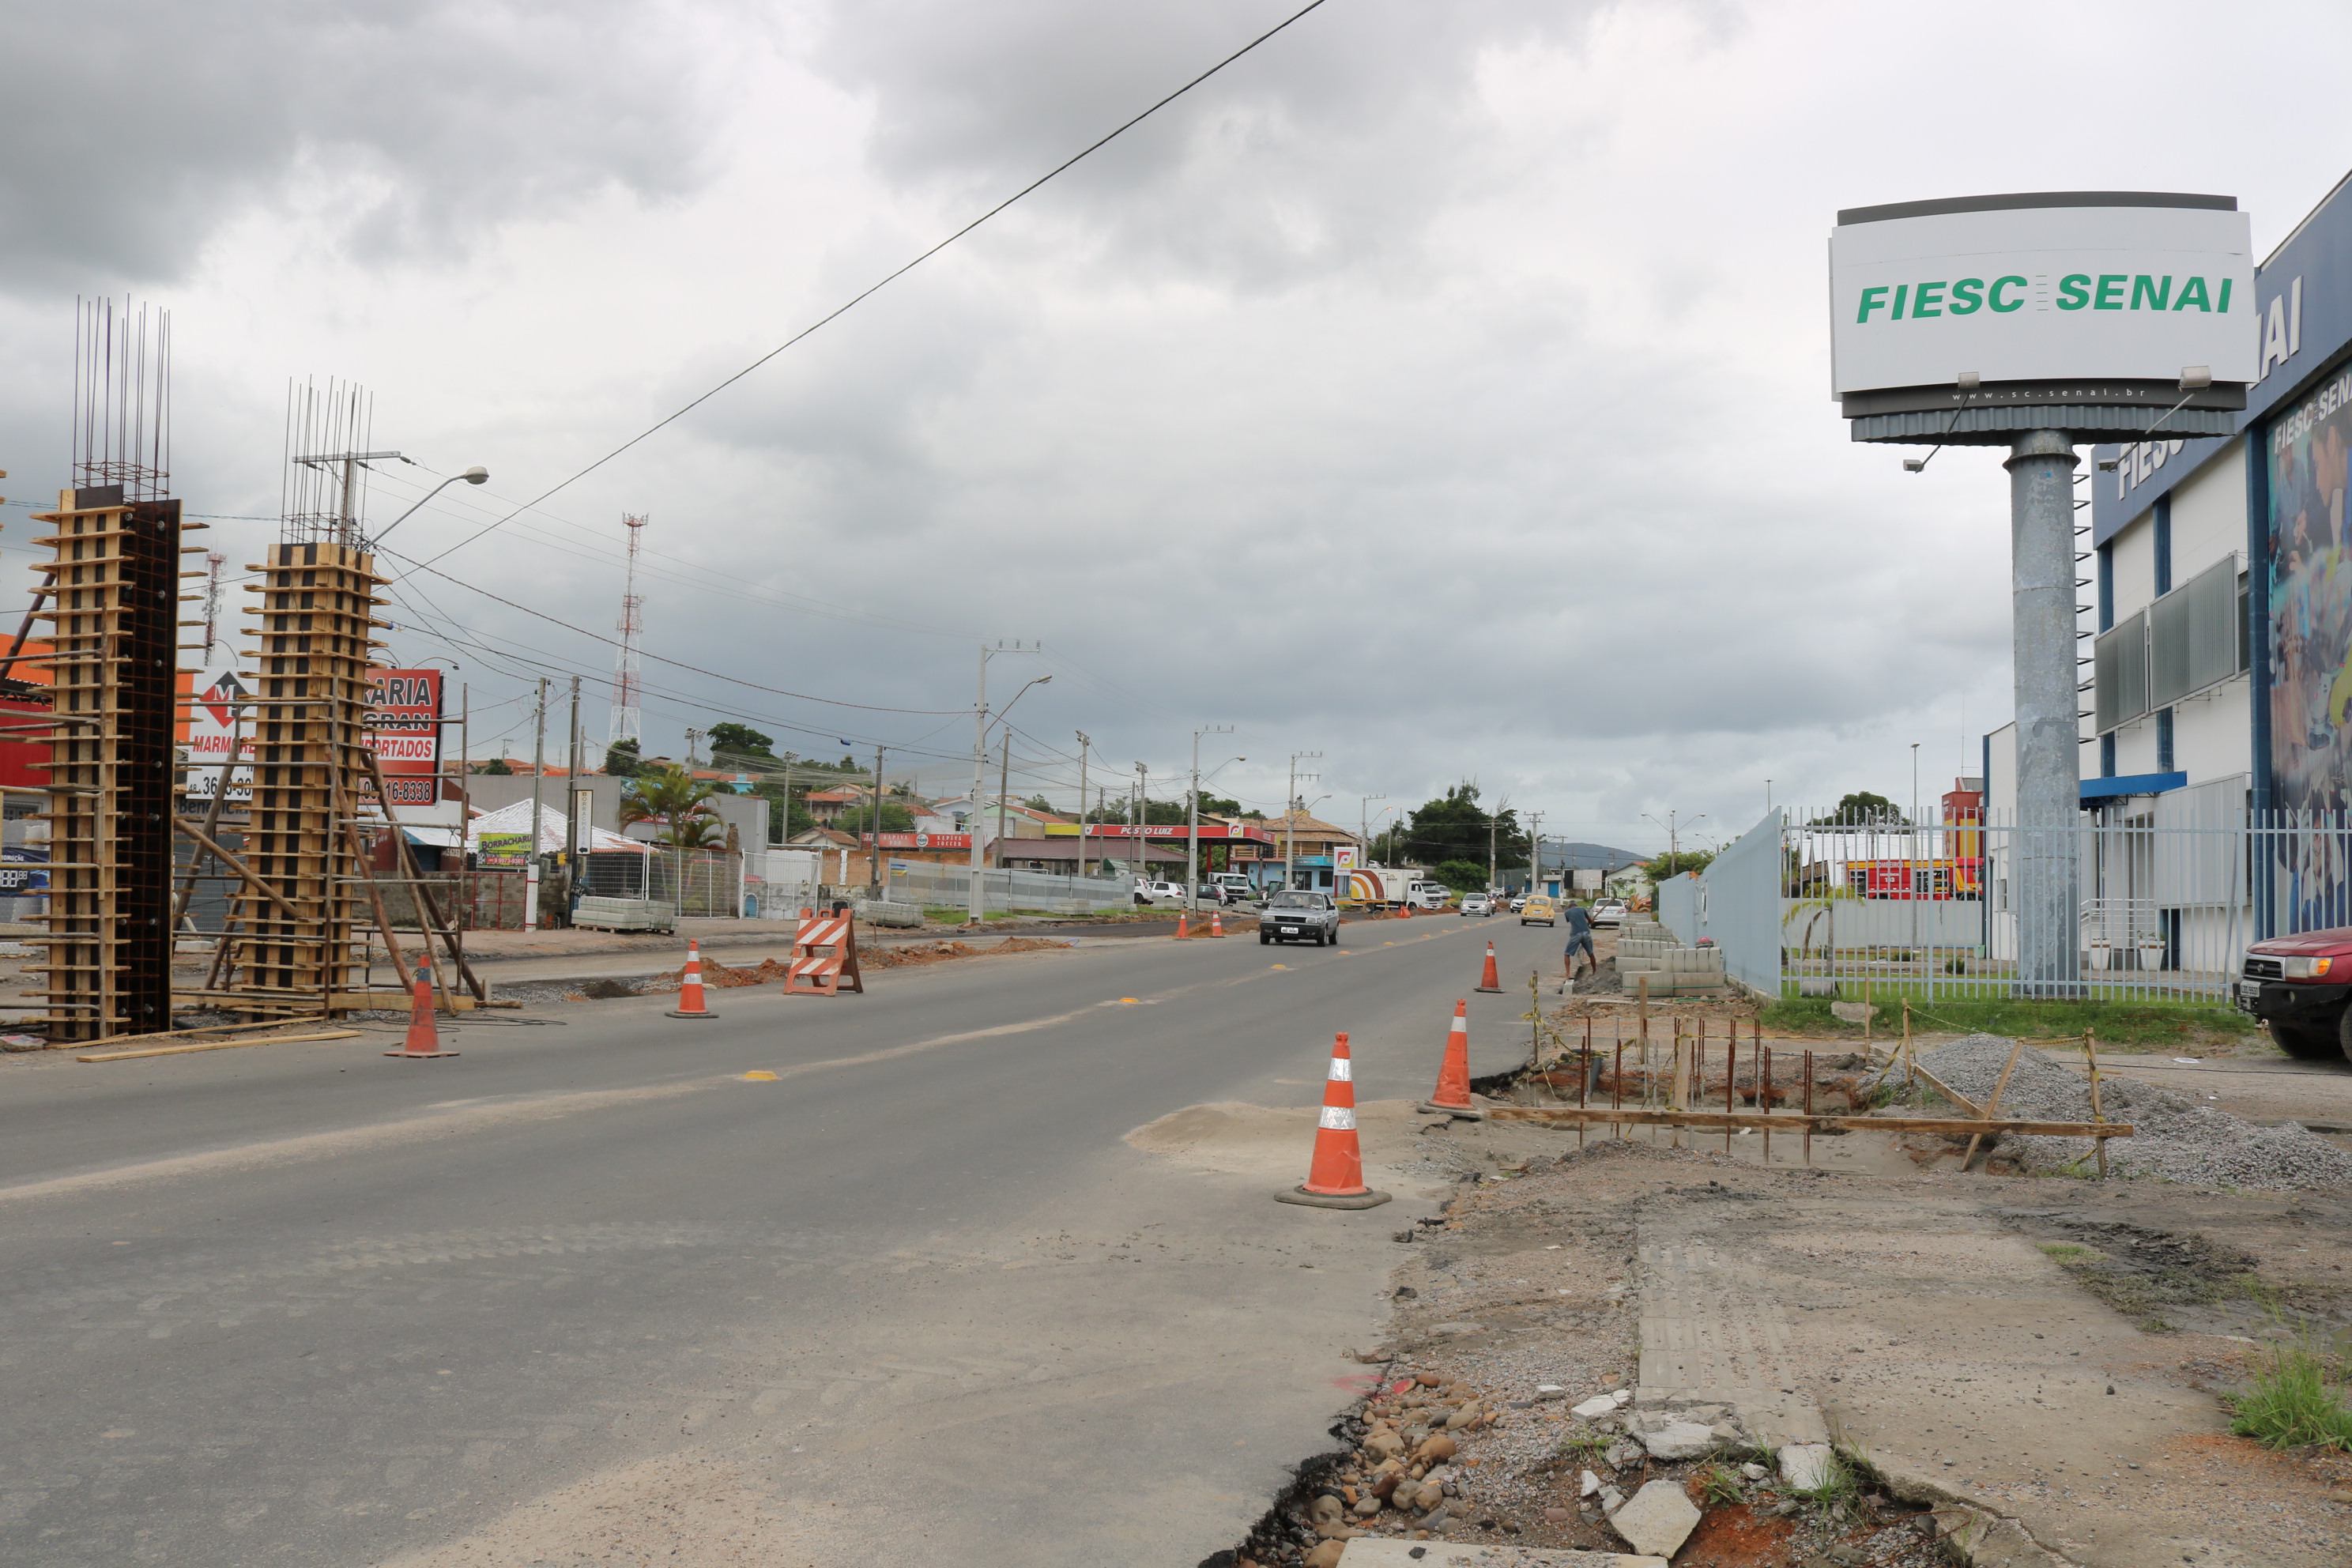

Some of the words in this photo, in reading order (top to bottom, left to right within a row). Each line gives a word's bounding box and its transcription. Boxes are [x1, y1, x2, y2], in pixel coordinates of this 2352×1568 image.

[1856, 275, 2028, 324] FIESC
[2056, 273, 2233, 313] SENAI
[1952, 388, 2145, 401] www.sc.senai.br
[2274, 401, 2313, 454] FIESC
[361, 739, 432, 758] PORTADOS
